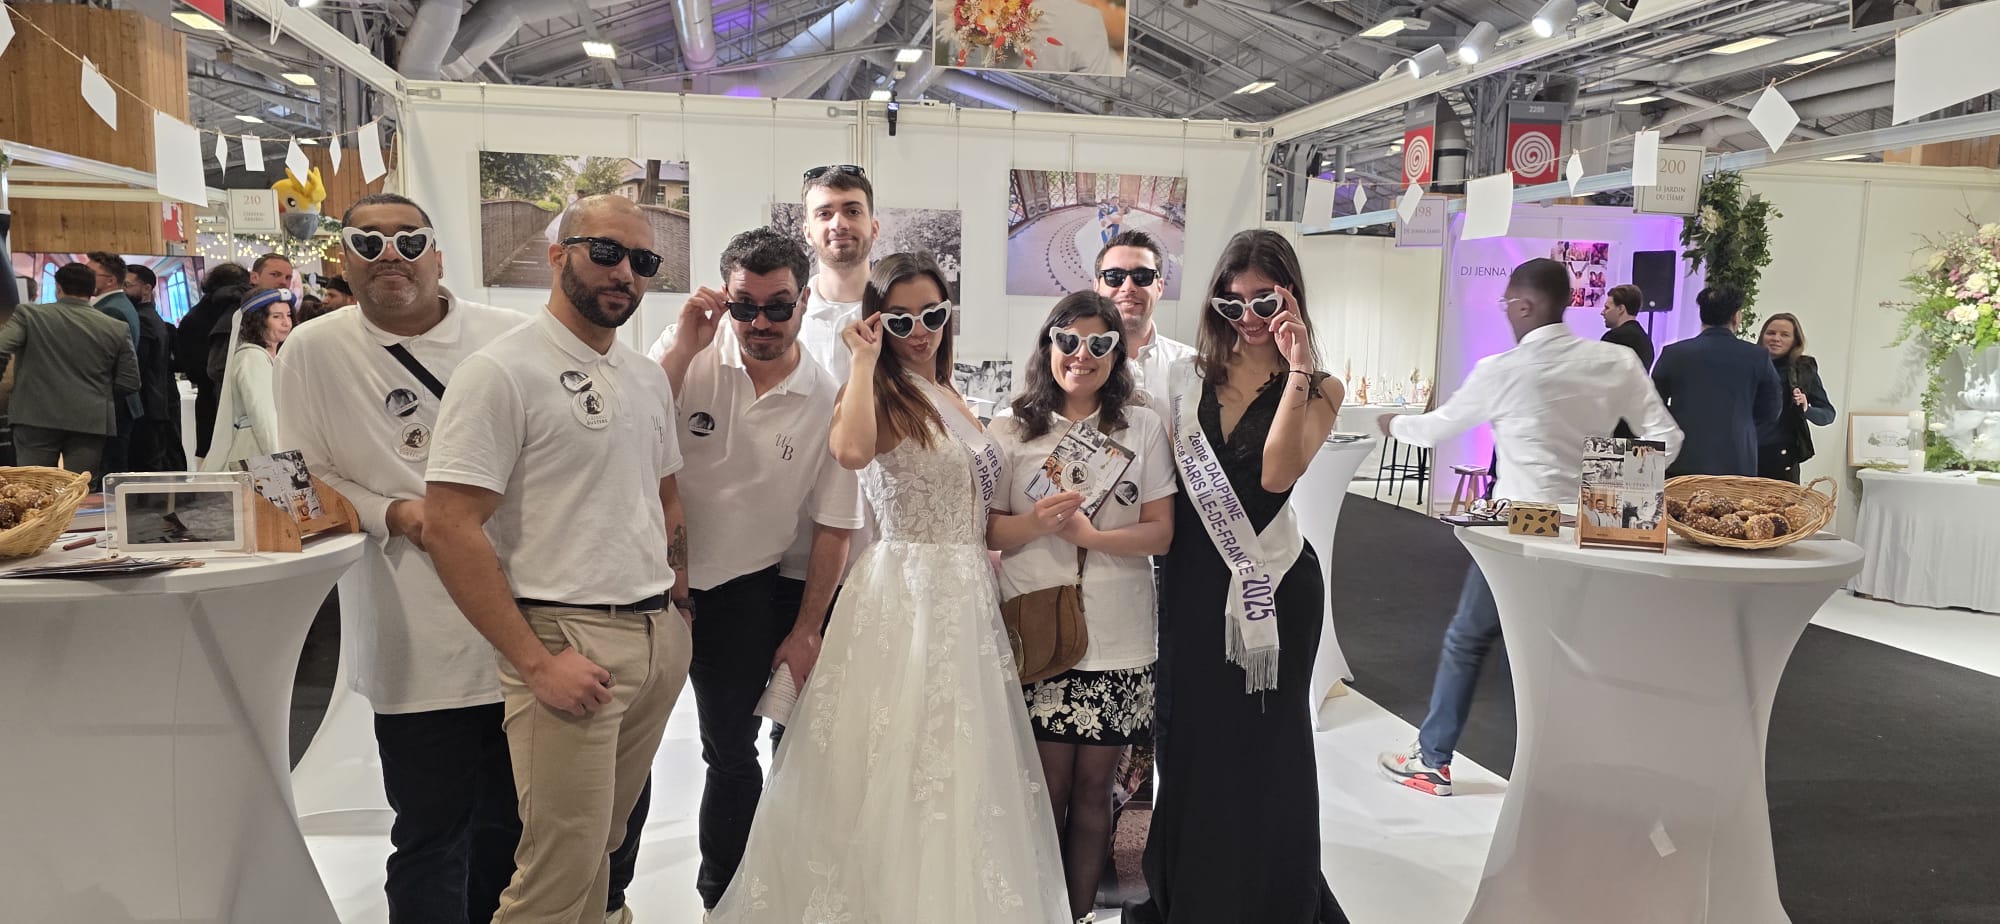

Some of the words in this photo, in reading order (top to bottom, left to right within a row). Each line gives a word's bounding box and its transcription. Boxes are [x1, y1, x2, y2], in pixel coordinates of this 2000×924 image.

[1659, 158, 1686, 174] 200
[1663, 184, 1686, 193] JARDIN
[243, 195, 261, 205] 210
[1415, 206, 1432, 217] 198
[1460, 265, 1473, 276] DJ
[1474, 266, 1507, 277] JENNA
[978, 465, 994, 501] PARIS
[1188, 431, 1209, 462] 2ème
[1204, 461, 1245, 521] DAUPHINE
[1181, 456, 1206, 491] PARIS
[1196, 488, 1255, 576] ÎLE-DE-FRANCE
[1242, 574, 1275, 621] 2025
